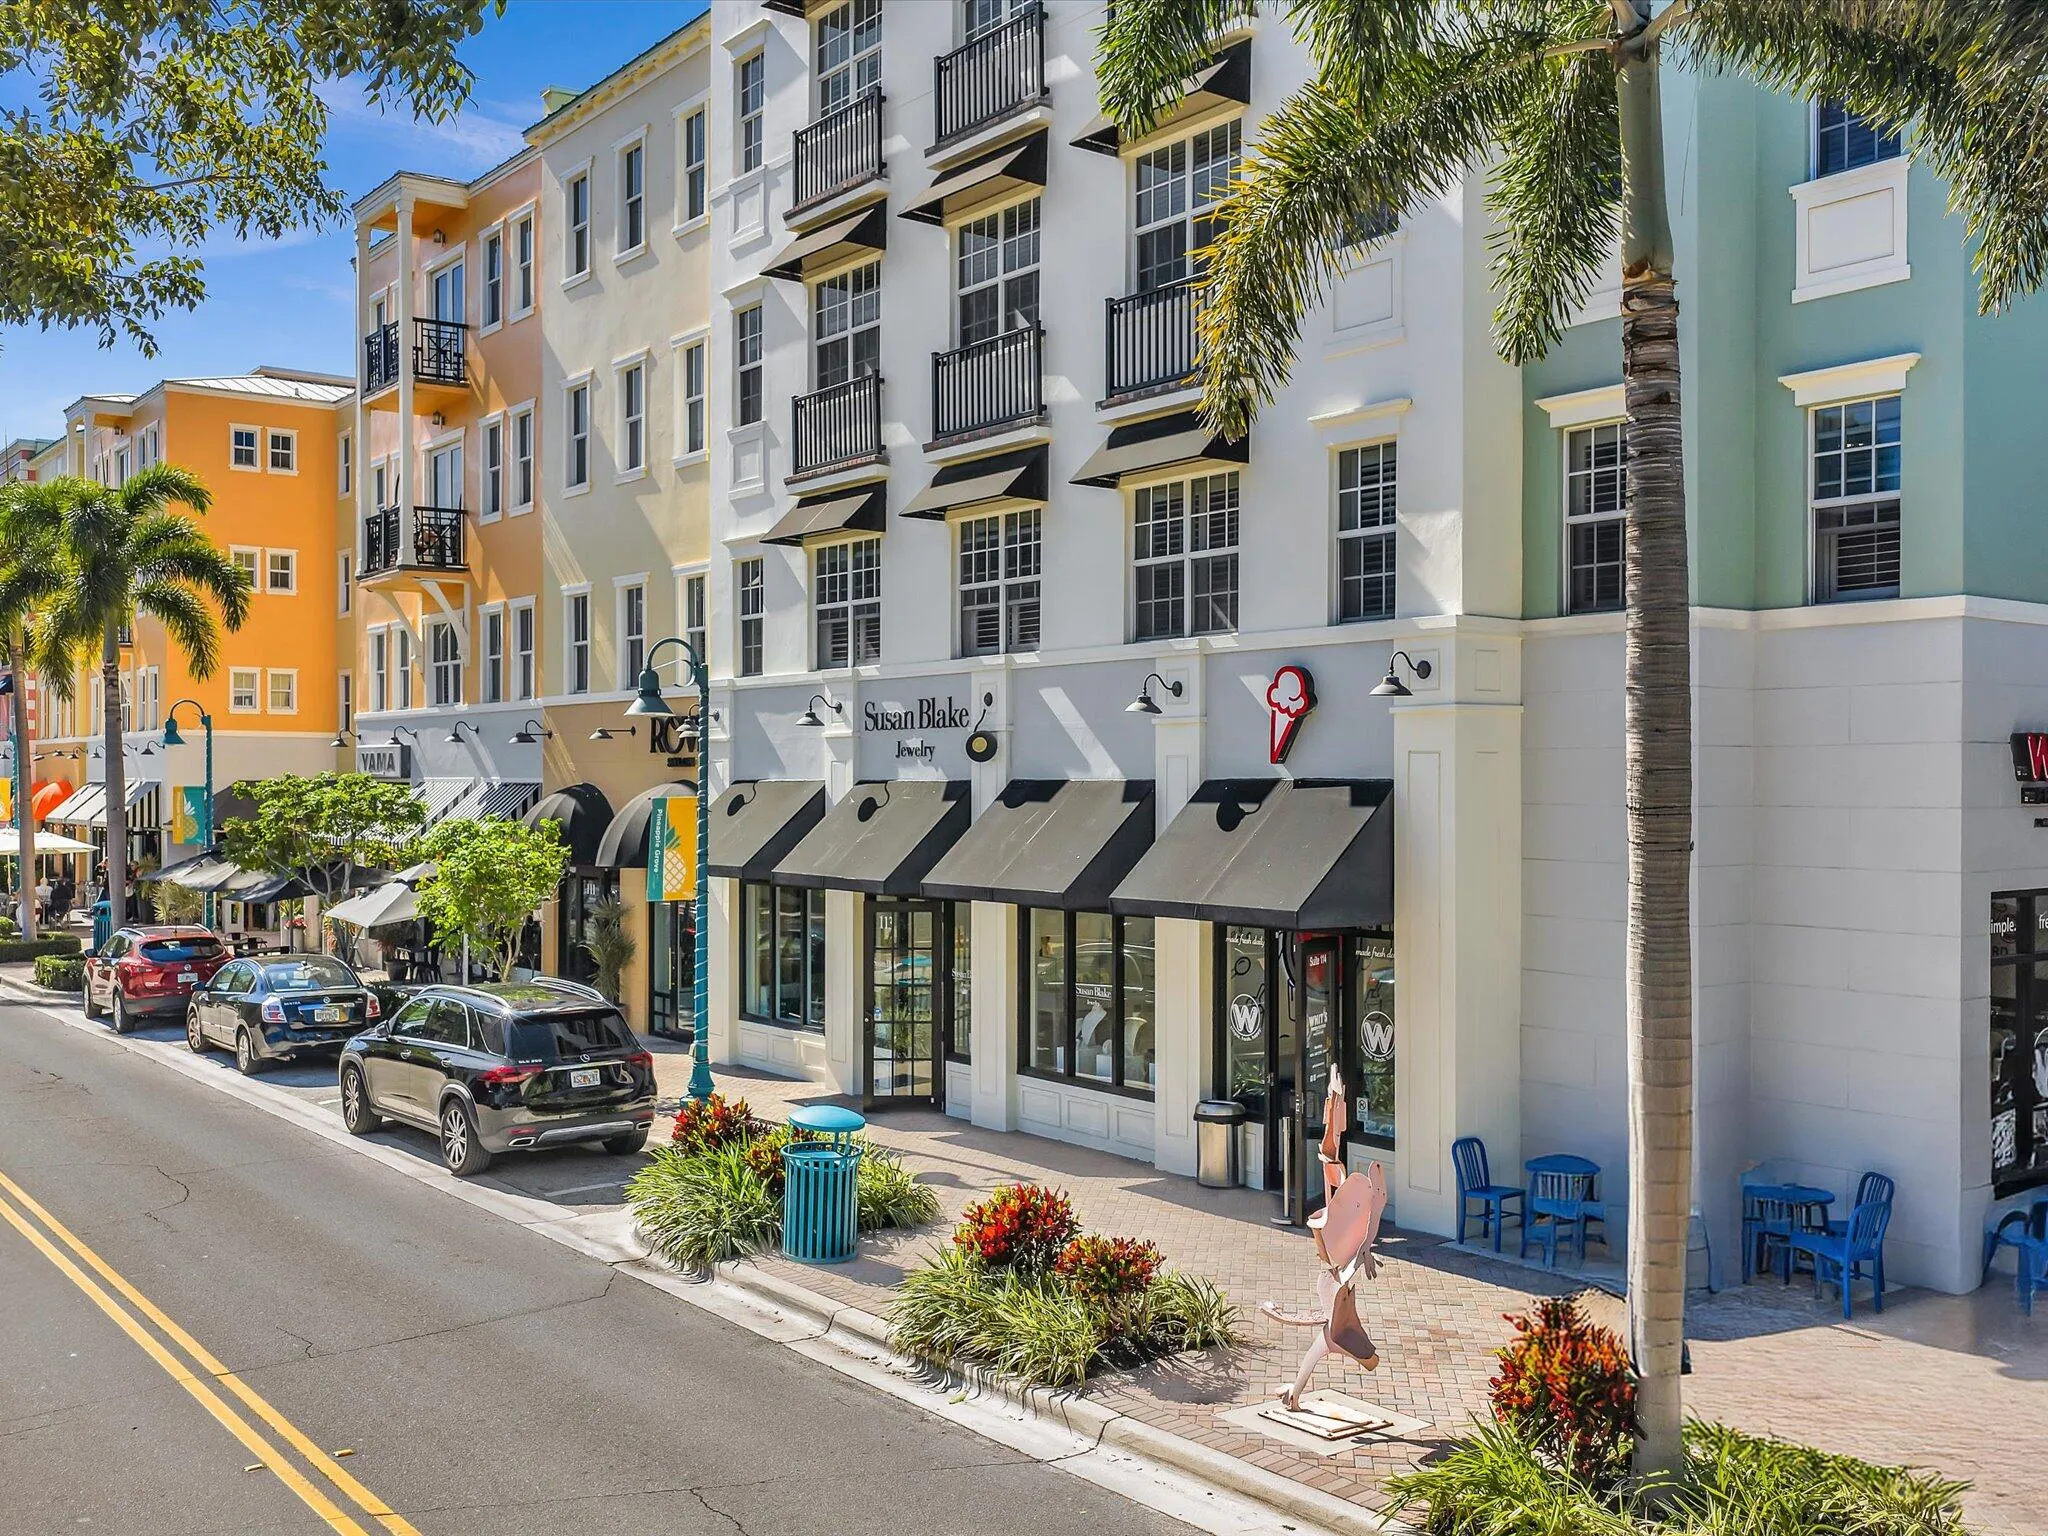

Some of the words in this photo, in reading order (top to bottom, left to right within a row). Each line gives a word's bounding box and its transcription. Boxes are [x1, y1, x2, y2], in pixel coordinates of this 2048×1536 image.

[864, 701, 914, 731] Susan
[918, 696, 970, 730] Blake
[895, 740, 936, 762] Jewelry
[361, 752, 396, 772] YAMA
[655, 808, 663, 848] Pineapple
[653, 849, 661, 873] Grove
[1990, 917, 2017, 937] imple.
[2038, 911, 2048, 930] fre
[1355, 946, 1371, 957] made
[1370, 946, 1386, 960] fresh
[1076, 985, 1094, 996] Susan
[1094, 986, 1112, 999] Blake
[1232, 1003, 1259, 1034] W
